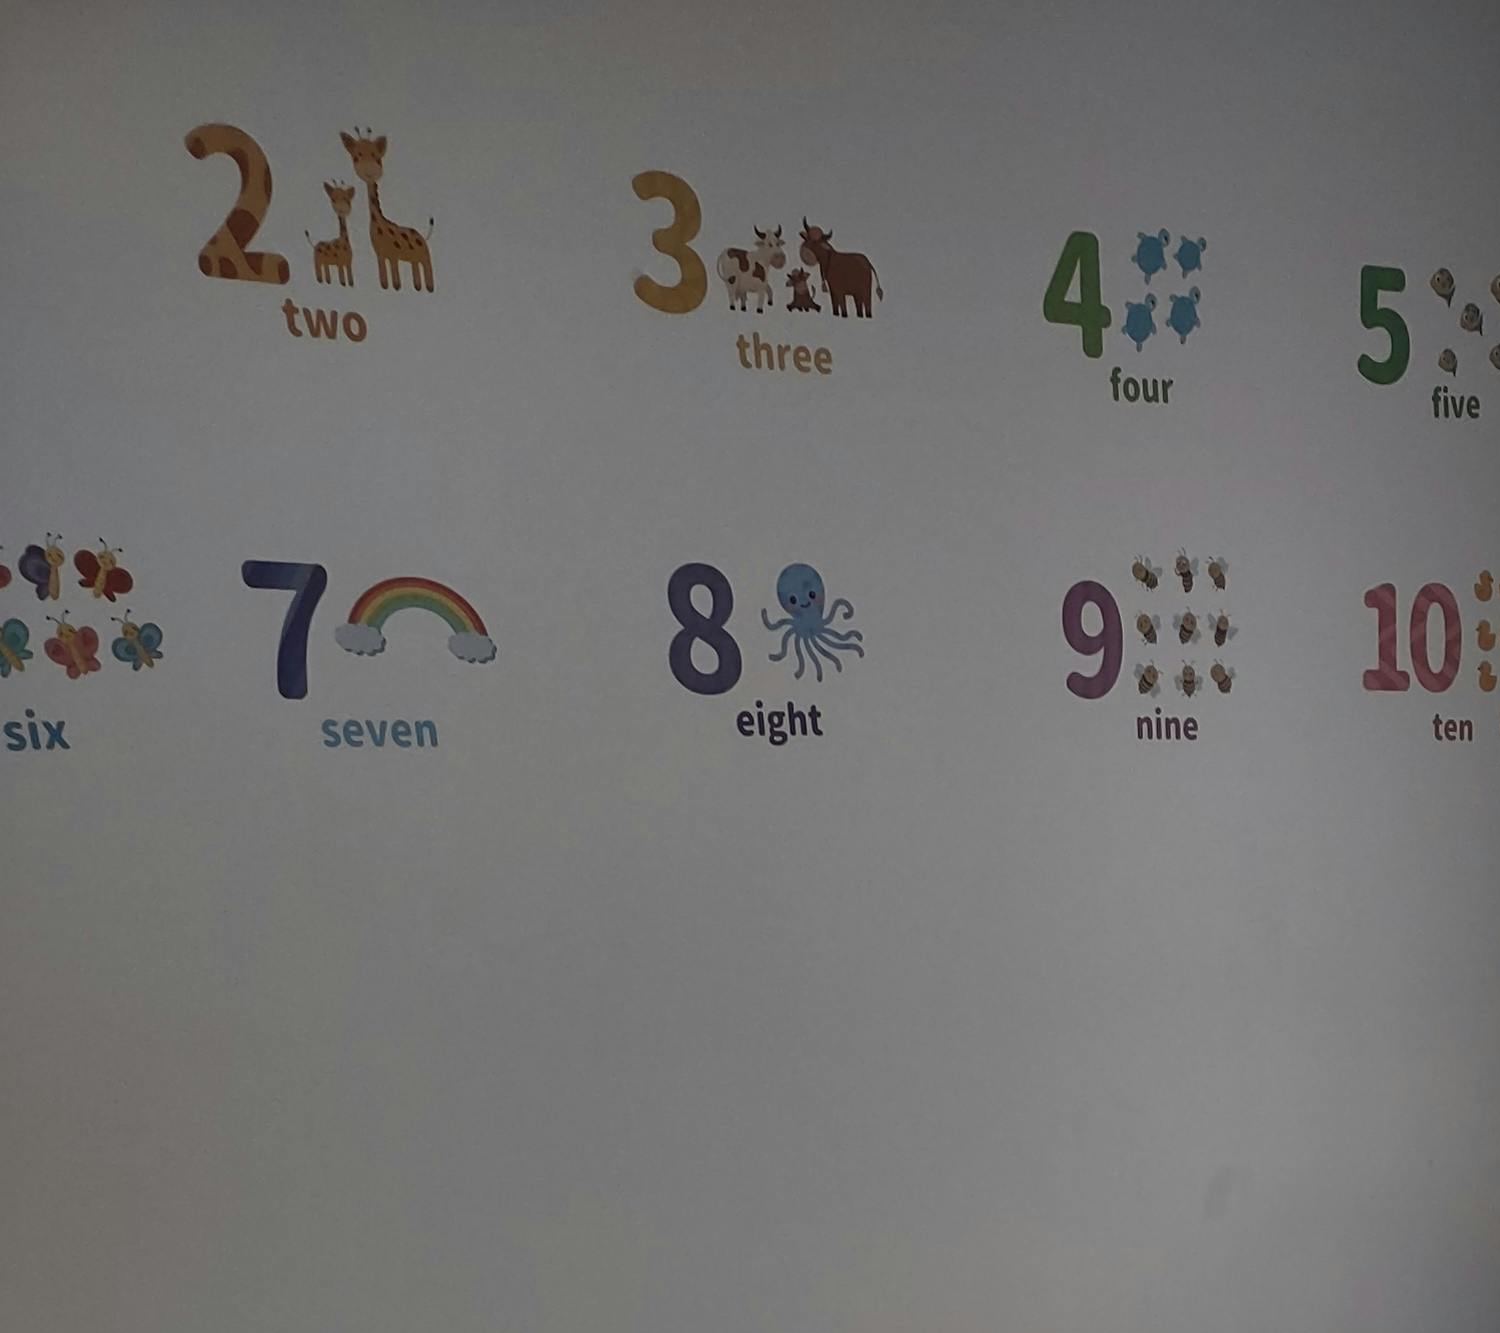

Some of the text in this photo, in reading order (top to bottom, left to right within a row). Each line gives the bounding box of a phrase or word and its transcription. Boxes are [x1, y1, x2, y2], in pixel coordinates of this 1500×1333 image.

[184, 123, 290, 285] 2
[632, 170, 708, 314] 3
[1043, 231, 1111, 358] 4
[282, 298, 367, 342] two
[1357, 265, 1410, 385] 5
[736, 332, 832, 375] three
[1110, 367, 1173, 403] four
[1432, 386, 1480, 419] five
[241, 560, 327, 700] 7
[667, 563, 742, 695] 8
[1062, 580, 1123, 699] 9
[1363, 583, 1462, 693] 10
[3, 709, 70, 751] six
[321, 719, 438, 748] seven
[737, 700, 823, 746] eight
[1137, 707, 1198, 740] nine
[1433, 714, 1473, 741] ten
